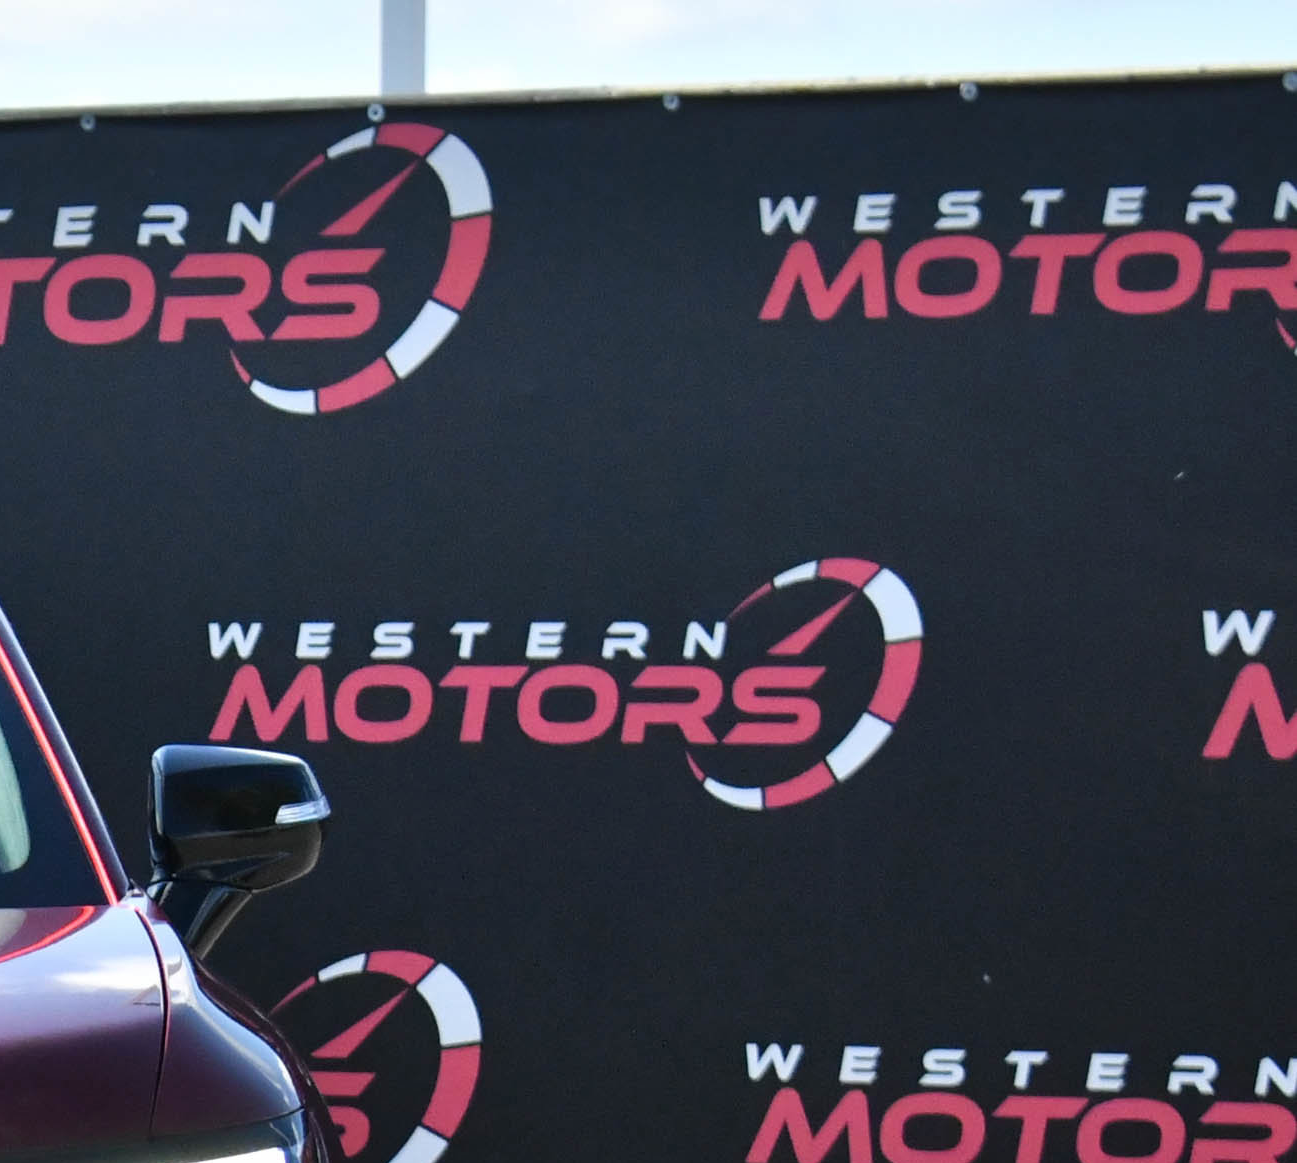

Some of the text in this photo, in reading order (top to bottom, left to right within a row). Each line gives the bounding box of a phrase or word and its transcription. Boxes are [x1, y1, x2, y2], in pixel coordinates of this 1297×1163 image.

[208, 621, 727, 660] WESTERN
[208, 663, 826, 745] MOTORS
[745, 1042, 1297, 1098] WESTERN
